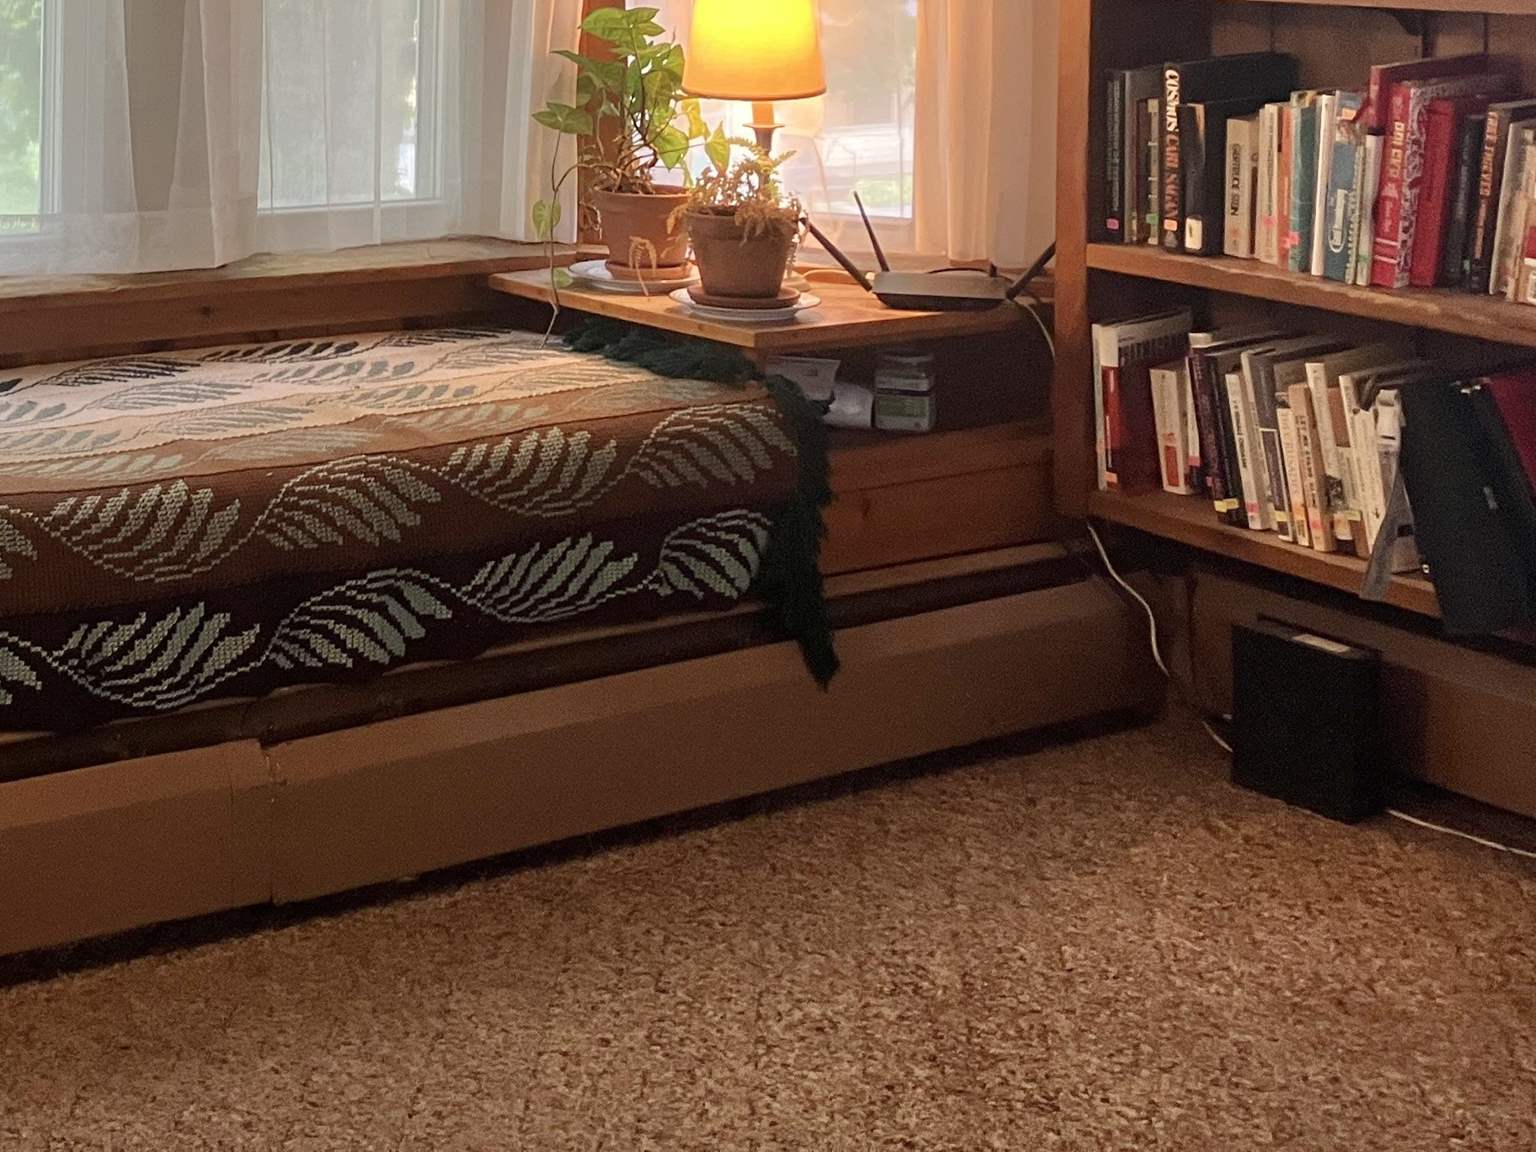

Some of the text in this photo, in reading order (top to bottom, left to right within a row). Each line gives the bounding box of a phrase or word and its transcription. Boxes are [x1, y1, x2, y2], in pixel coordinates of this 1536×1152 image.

[1165, 69, 1180, 132] COSMOS
[1165, 134, 1179, 169] CARL
[1230, 144, 1241, 216] GERTRUDE STEIN
